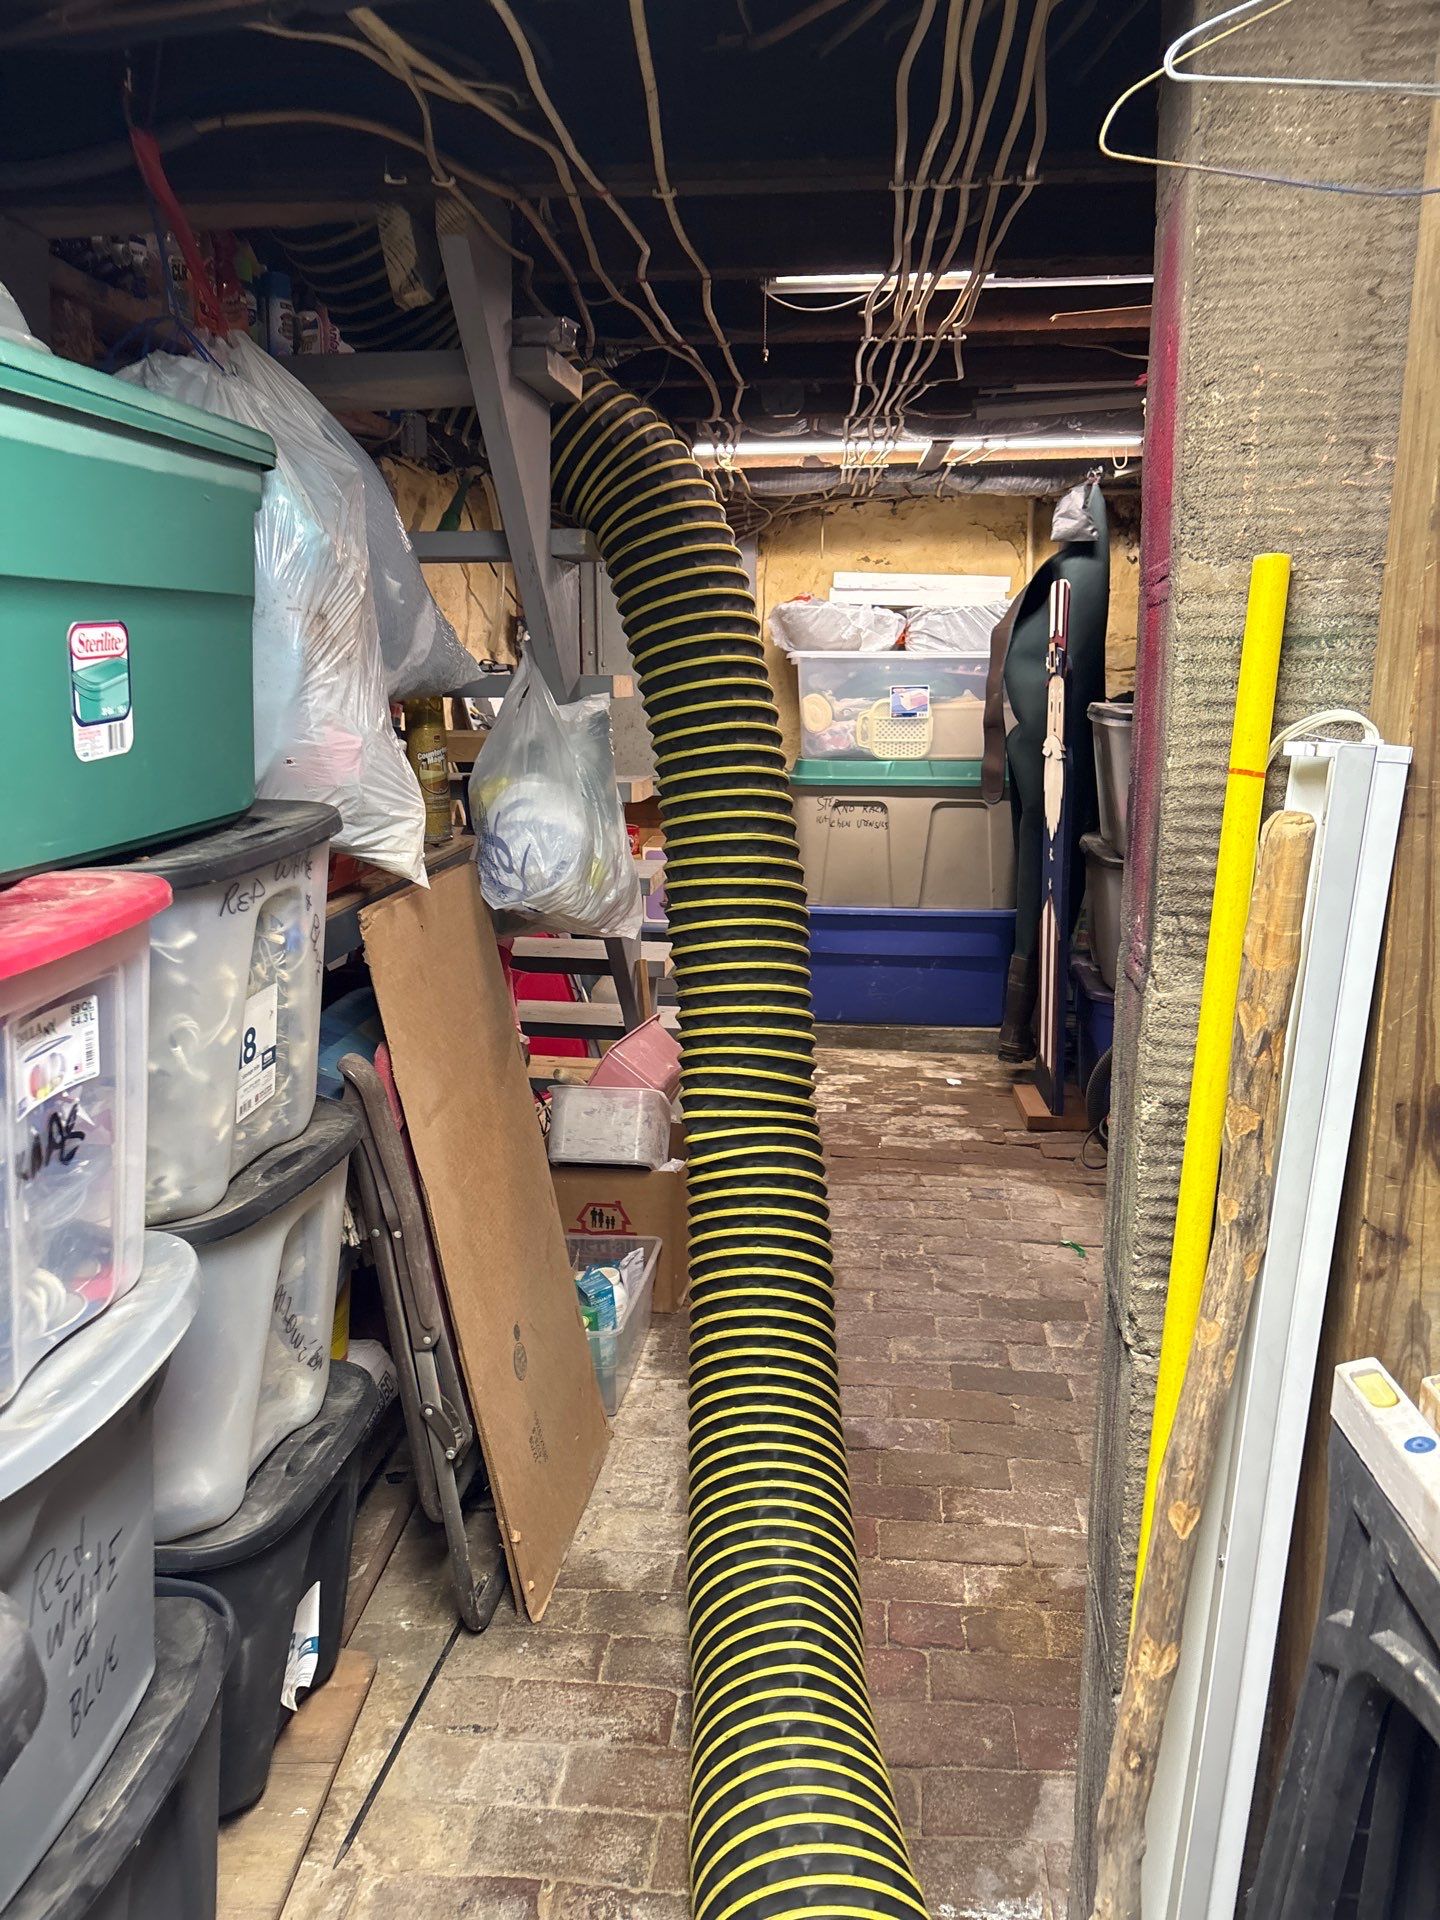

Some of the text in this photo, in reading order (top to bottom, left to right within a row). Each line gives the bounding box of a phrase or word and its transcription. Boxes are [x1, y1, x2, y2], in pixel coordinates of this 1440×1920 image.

[78, 631, 121, 653] Sterilite
[219, 878, 266, 917] RED
[69, 1634, 119, 1739] BLUE
